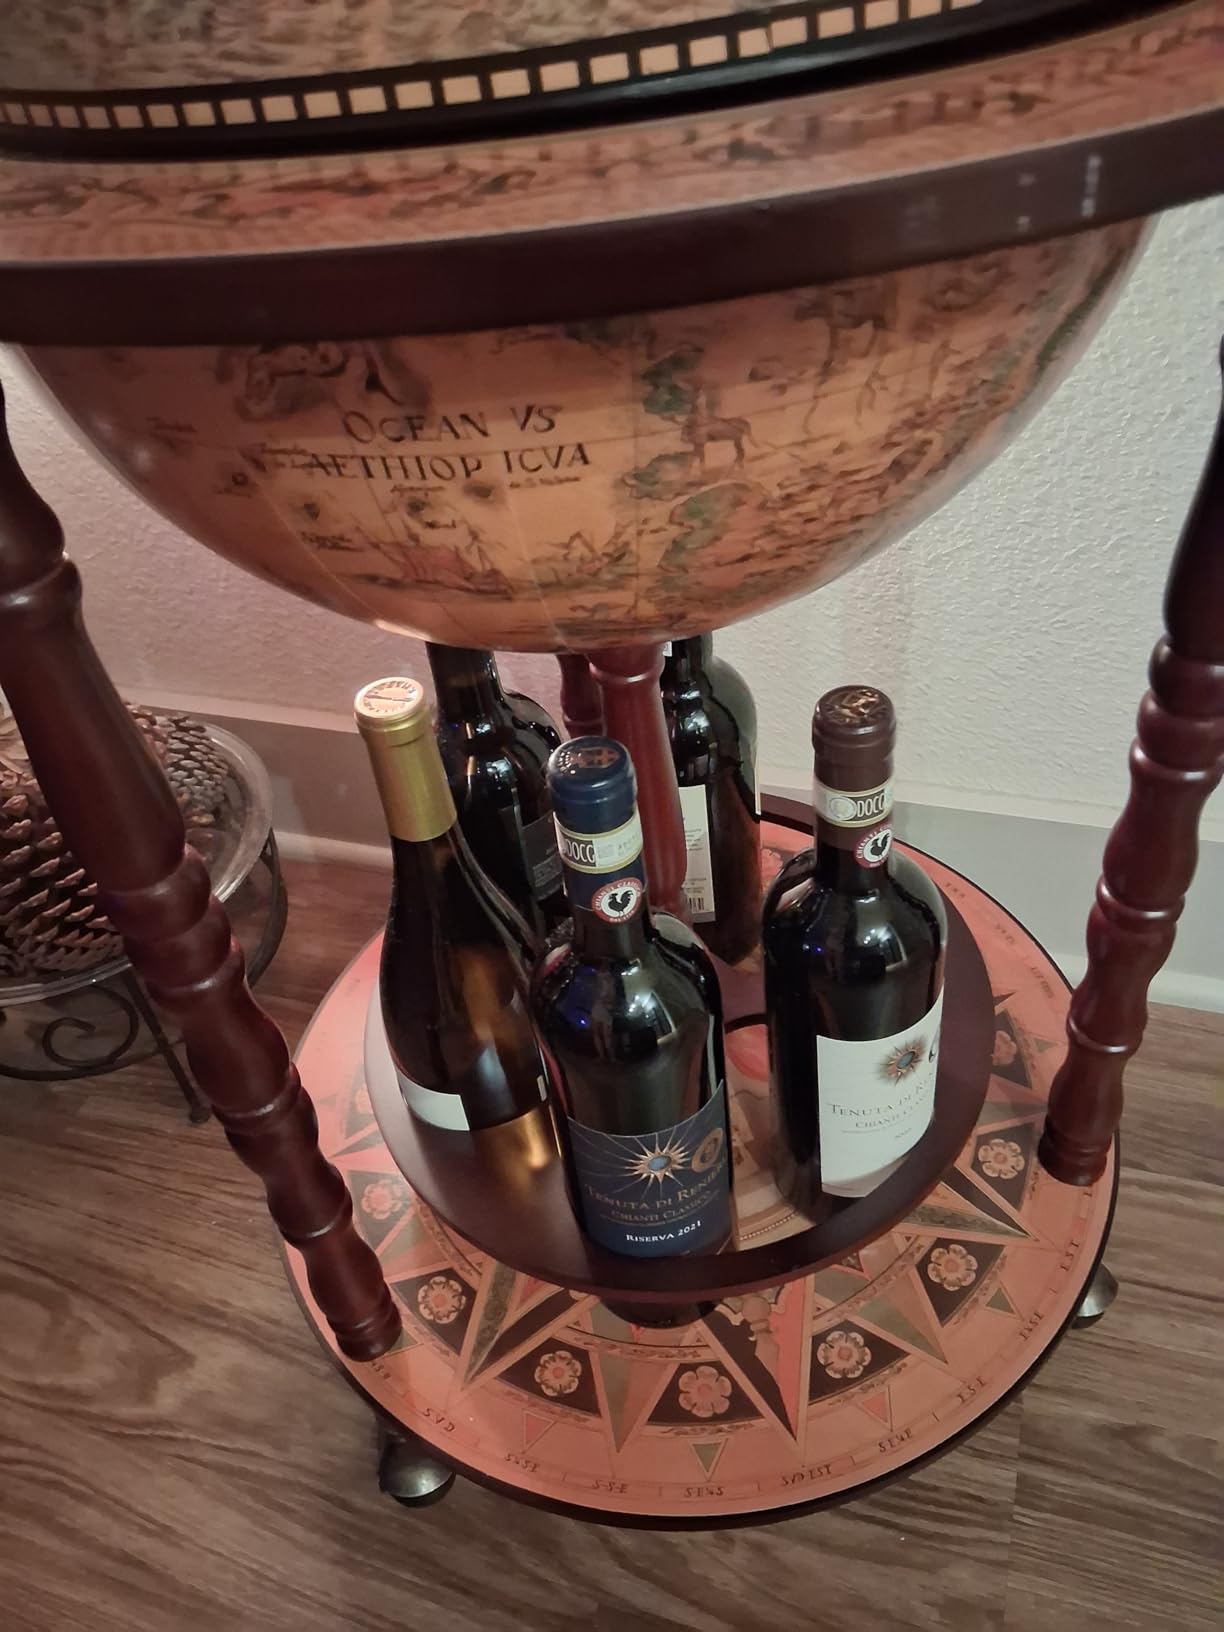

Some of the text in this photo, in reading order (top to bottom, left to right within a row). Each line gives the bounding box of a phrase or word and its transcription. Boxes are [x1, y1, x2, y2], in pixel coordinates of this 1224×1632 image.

[342, 404, 562, 444] OCEAN VS
[503, 443, 591, 474] ICVA
[655, 1197, 673, 1210] DI
[625, 1219, 702, 1243] RISERVA 2021
